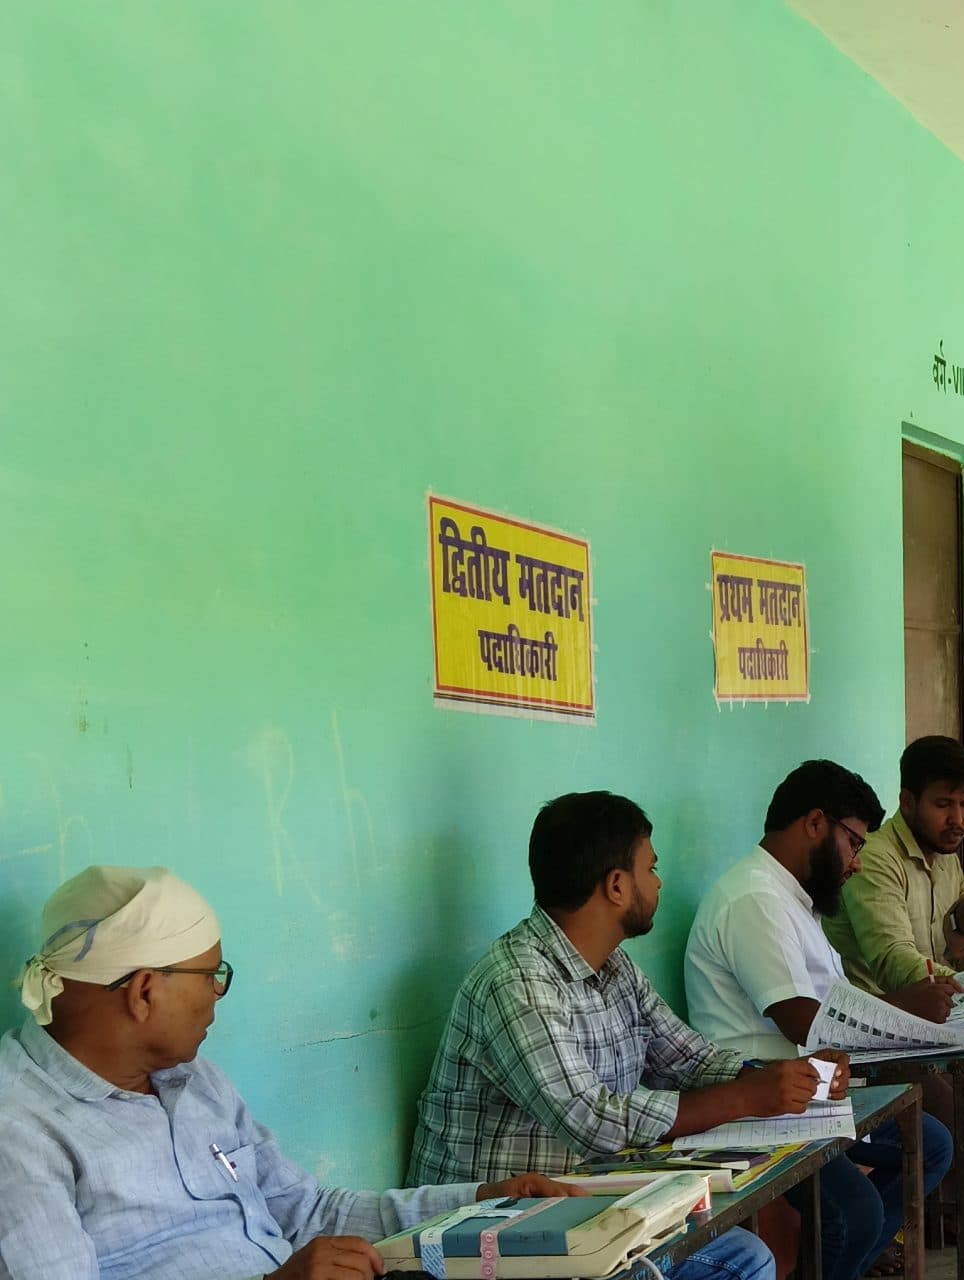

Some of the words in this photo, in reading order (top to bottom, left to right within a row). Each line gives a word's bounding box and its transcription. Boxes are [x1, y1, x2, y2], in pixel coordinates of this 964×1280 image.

[439, 517, 511, 605] द्वितीय
[515, 554, 585, 623] मतदान
[717, 574, 754, 624] प्रथम
[757, 578, 801, 627] मतदान
[478, 623, 557, 681] पदाधिकारी
[738, 637, 789, 681] पदाधिकारी
